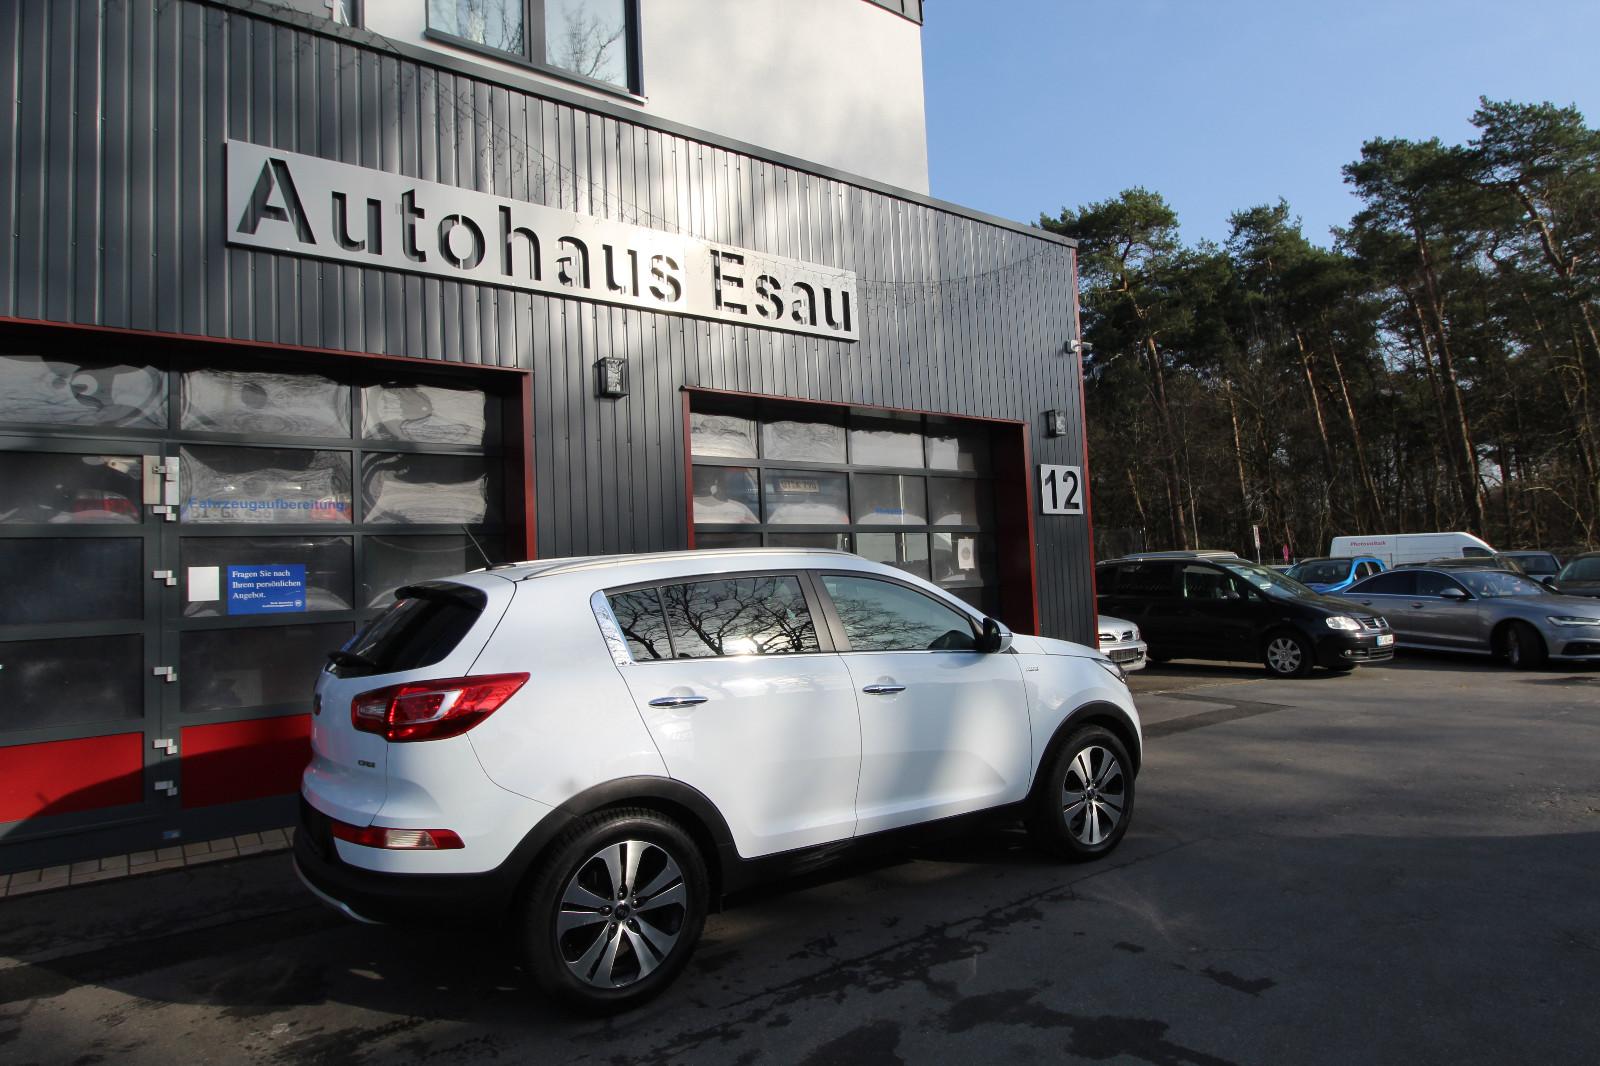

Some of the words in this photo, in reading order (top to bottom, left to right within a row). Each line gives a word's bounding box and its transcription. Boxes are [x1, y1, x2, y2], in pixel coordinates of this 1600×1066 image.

[236, 157, 683, 303] Autohaus
[709, 248, 853, 333] Esau
[1045, 469, 1080, 510] 12
[188, 496, 346, 512] Fahrzeugaufbereitung
[232, 570, 257, 579] Fragen
[273, 569, 291, 577] nach
[232, 581, 254, 589] Ihrem
[256, 580, 301, 589] persönlichen
[232, 592, 266, 600] Angebot.
